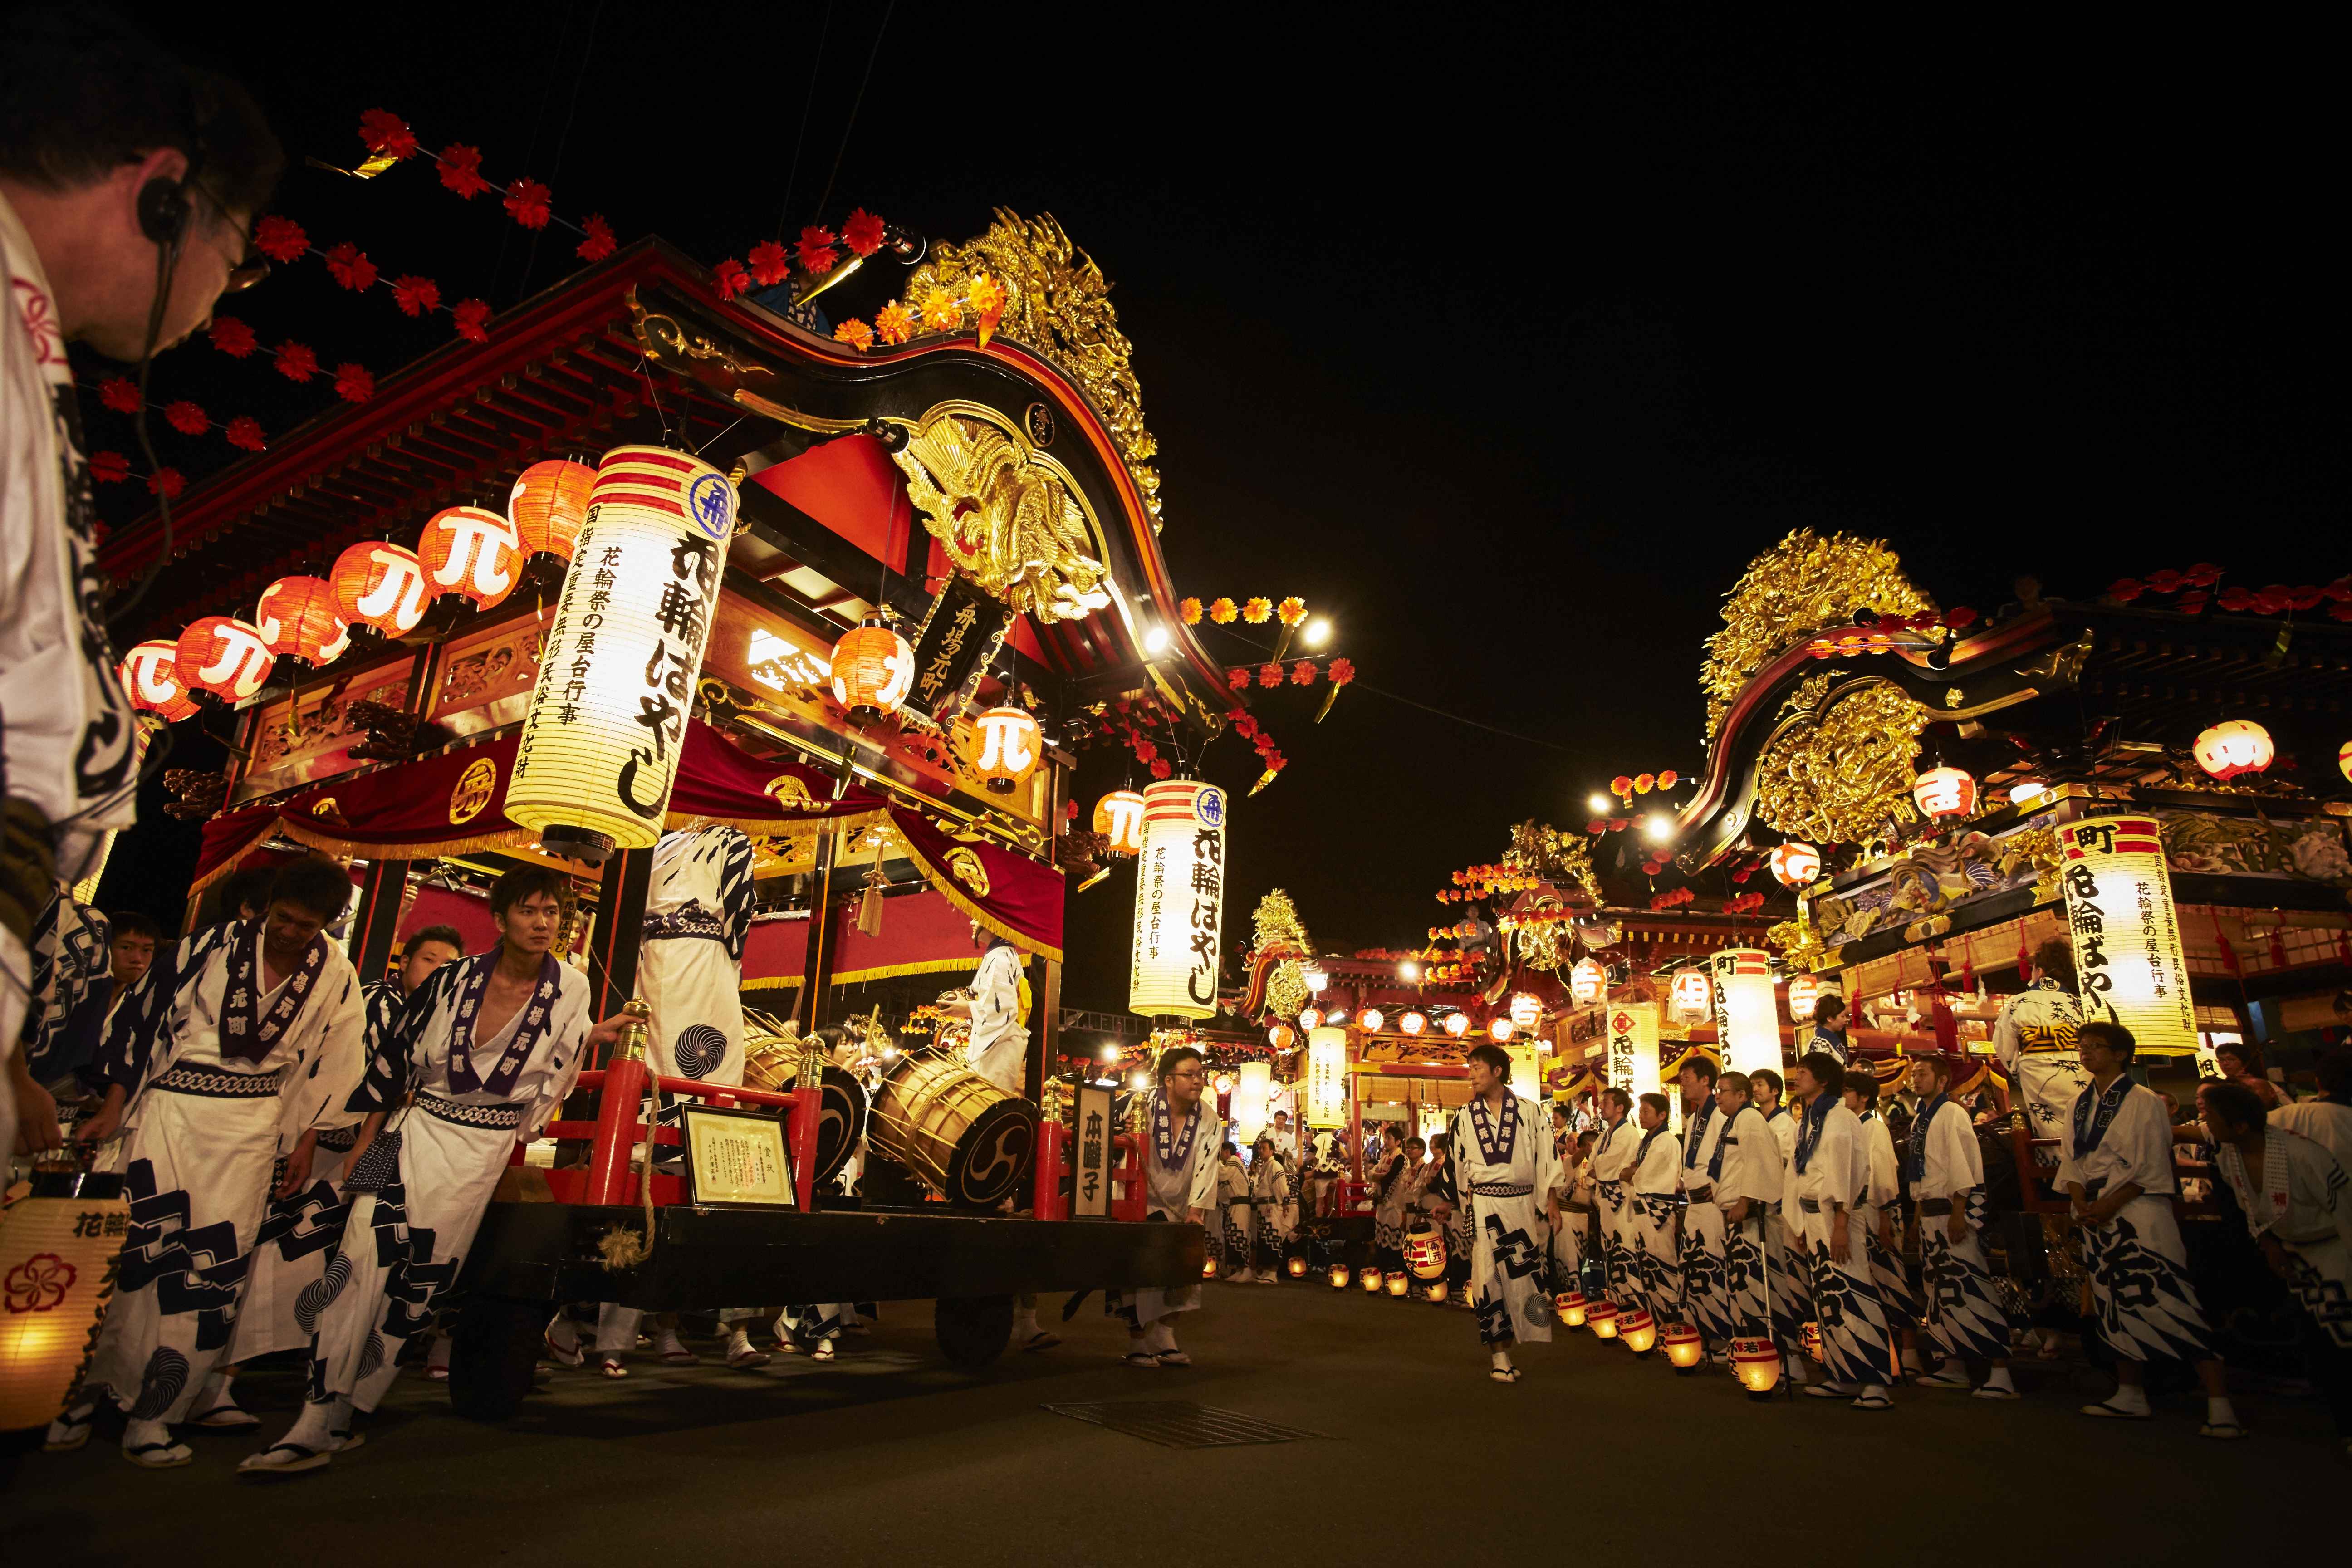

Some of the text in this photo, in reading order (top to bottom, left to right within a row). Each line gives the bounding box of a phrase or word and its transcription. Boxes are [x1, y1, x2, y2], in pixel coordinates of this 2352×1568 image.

[514, 505, 602, 779] 国指定重要無形民俗文化財
[557, 546, 623, 726] 花輪祭の屋台行事
[617, 529, 719, 821] 花輪ばやし
[920, 603, 976, 701] 舟場元町
[1133, 822, 1150, 993] 国指定重要無形民俗文化財
[1149, 847, 1166, 960] 花輪祭の屋台行事
[1188, 828, 1222, 1006] 花輪ばやし
[2135, 882, 2168, 998] 花輪祭の屋台行事
[2154, 855, 2192, 1032] 国指定重要無形民俗文化財
[500, 980, 554, 1076] 舟場元町
[764, 1147, 774, 1173] 賞状
[1082, 1110, 1104, 1201] 本囃子
[1473, 1101, 1494, 1154] 舟場元町
[1499, 1098, 1515, 1153] 舟場元町
[1624, 1315, 1635, 1324] 若
[1744, 1342, 1759, 1353] 若
